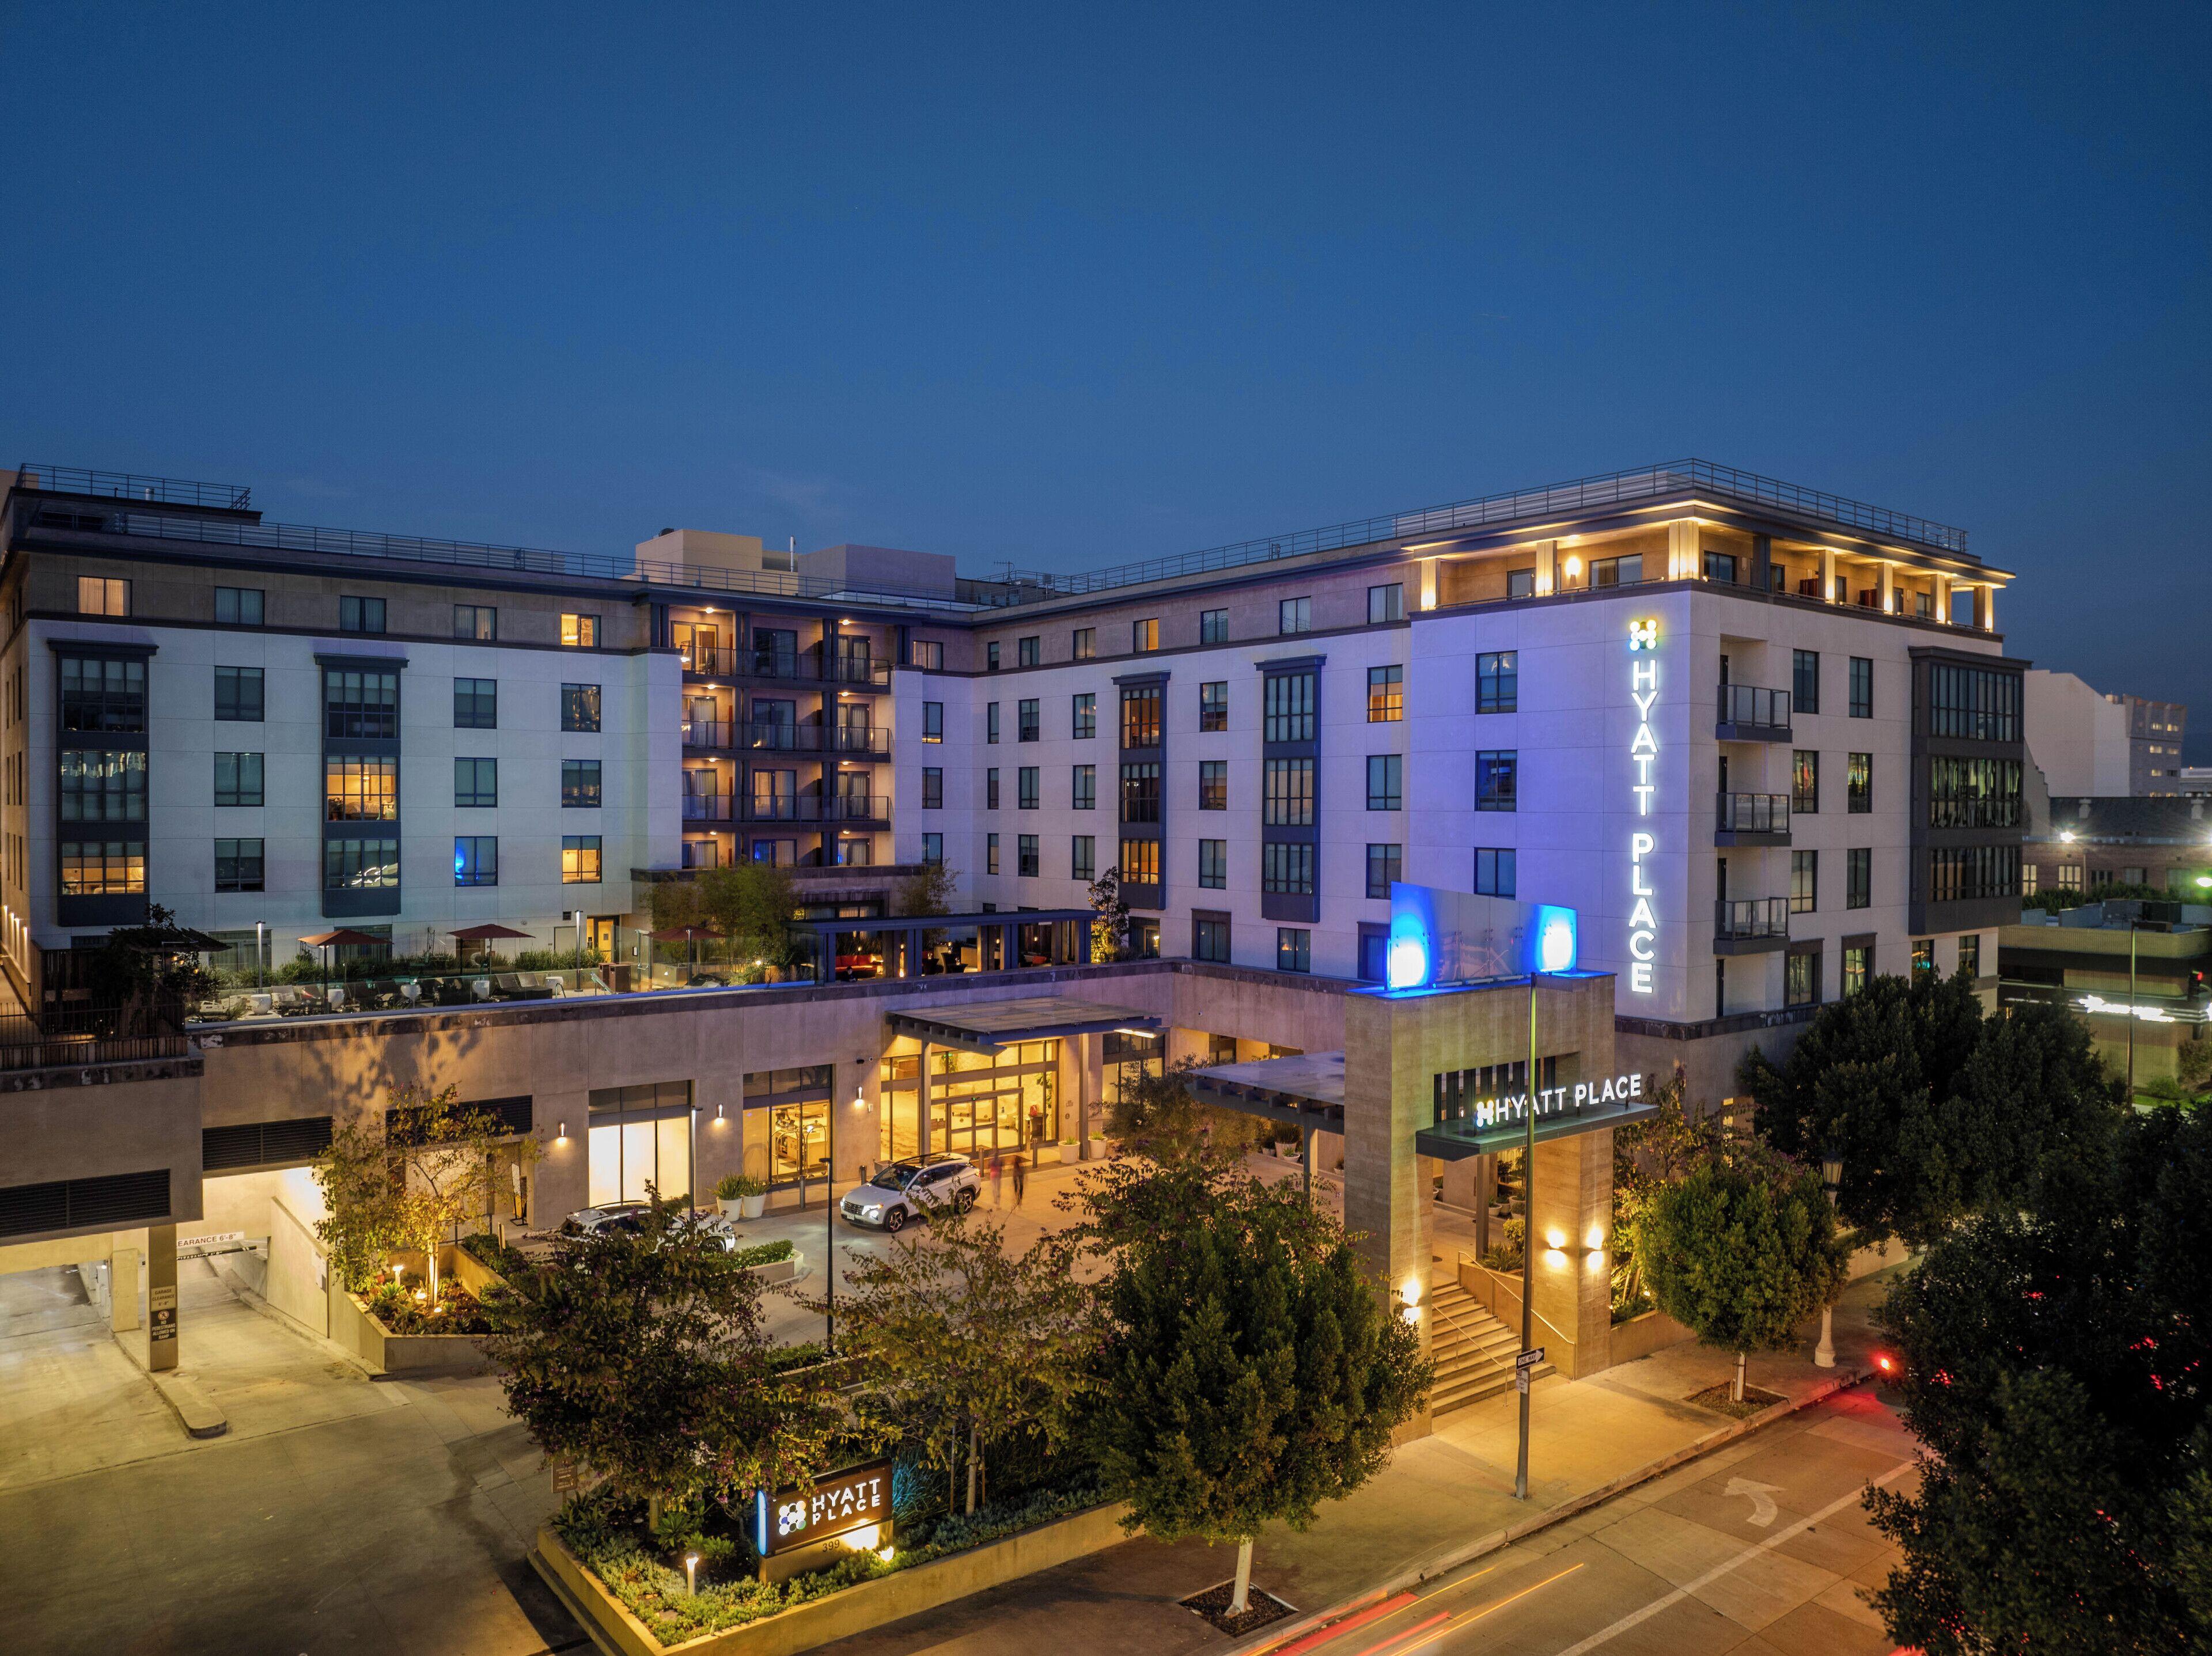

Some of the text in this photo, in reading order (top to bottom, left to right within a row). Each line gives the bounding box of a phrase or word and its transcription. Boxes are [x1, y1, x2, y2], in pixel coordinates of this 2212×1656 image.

[1628, 659, 1658, 994] HYATT PLACE
[1495, 1073, 1642, 1123] HYATT PLACE
[176, 1236, 218, 1247] EARANCE
[151, 1294, 175, 1302] CLEARANCE
[812, 1477, 881, 1513] HYATT
[812, 1494, 881, 1525] PLACE
[822, 1539, 840, 1552] 399
